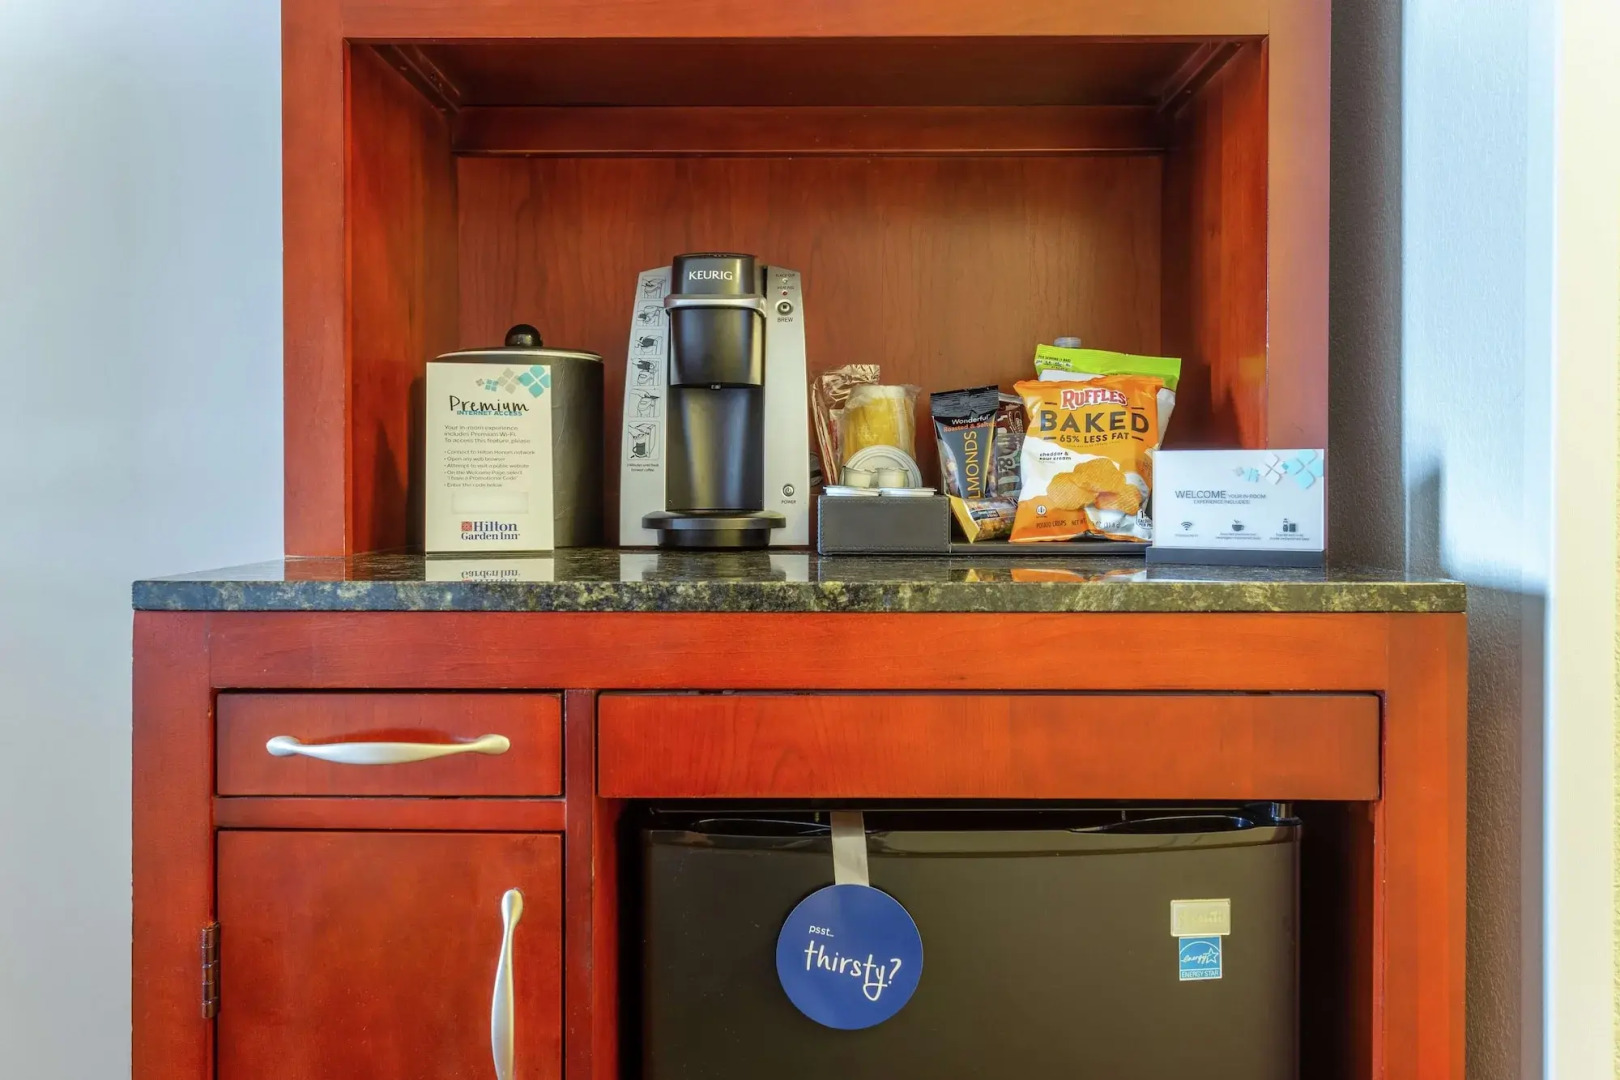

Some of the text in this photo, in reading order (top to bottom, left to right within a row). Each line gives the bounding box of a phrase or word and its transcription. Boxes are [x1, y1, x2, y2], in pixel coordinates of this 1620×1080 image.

[688, 270, 733, 281] KEURIG
[449, 395, 530, 412] Premium
[1060, 388, 1128, 410] RUFFLES
[952, 414, 991, 425] Wonderful
[1040, 410, 1149, 434] BAKED
[943, 424, 969, 433] Roasted
[1059, 432, 1130, 444] 65% LESS FAT
[1175, 490, 1227, 499] WELCOME
[473, 520, 518, 532] Hilton
[1052, 520, 1067, 528] CRISPS
[461, 532, 518, 540] Garden Inn
[804, 940, 902, 1001] thirsty?
